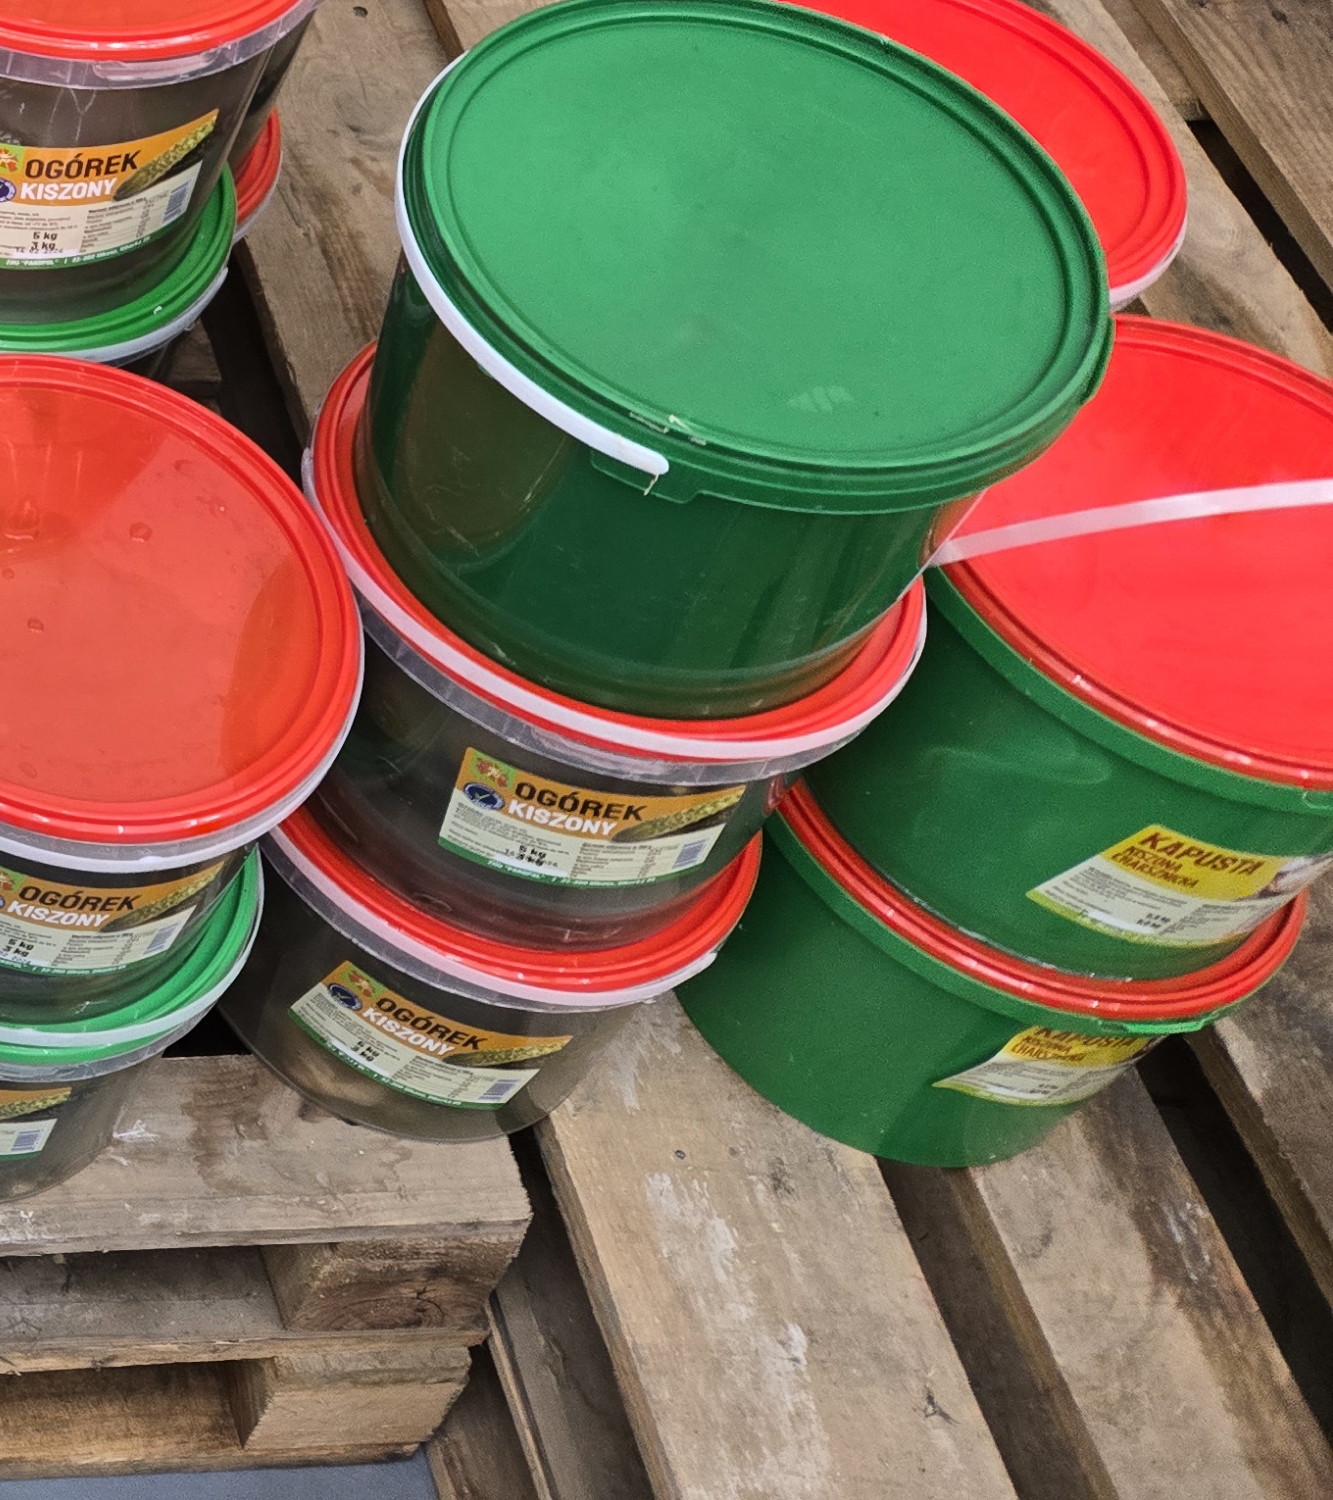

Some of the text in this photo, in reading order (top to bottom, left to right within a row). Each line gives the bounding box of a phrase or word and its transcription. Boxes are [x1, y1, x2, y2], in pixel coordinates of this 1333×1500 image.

[24, 149, 141, 180] OGÓREK
[19, 177, 119, 202] KISZONY
[505, 796, 619, 838] KISZONY
[512, 781, 647, 823] OGÓREK
[1139, 830, 1268, 878] KAPUSTA
[7, 900, 111, 928] KISZONY
[18, 885, 142, 913] OGÓREK
[361, 1006, 457, 1059] KISZONY
[374, 996, 488, 1052] OGÓREK
